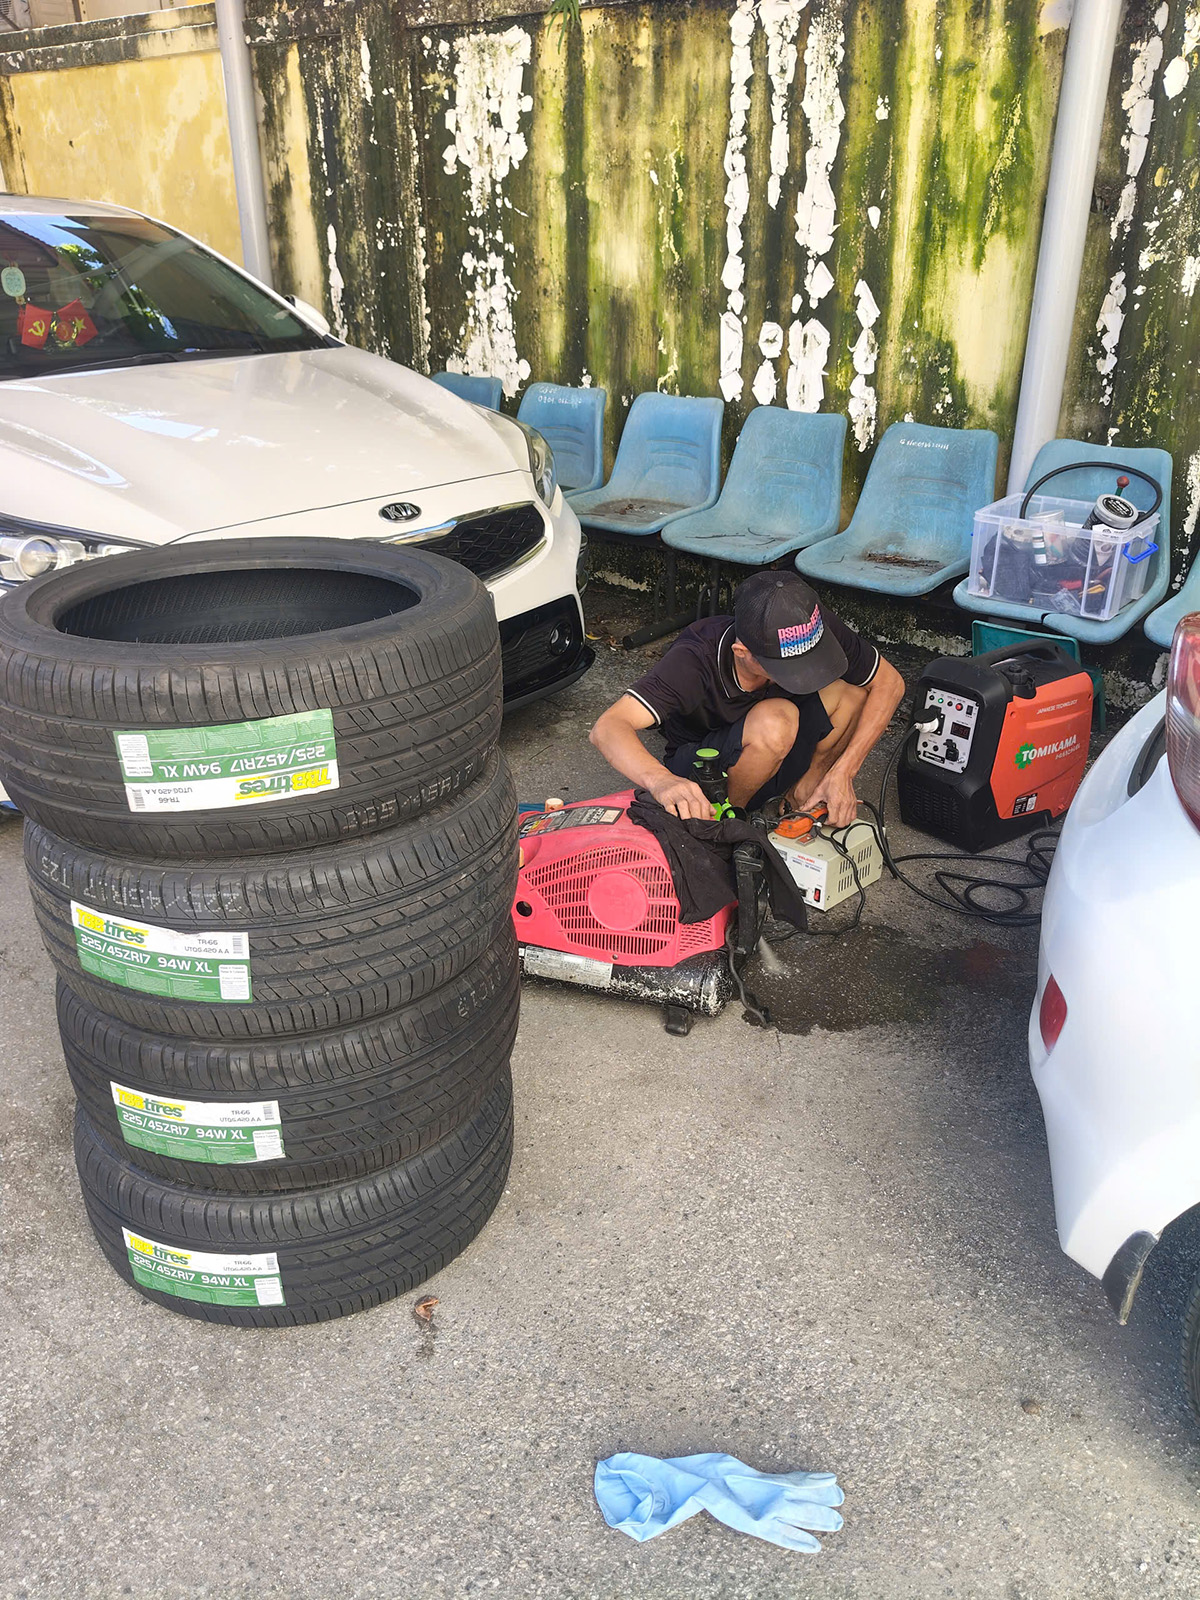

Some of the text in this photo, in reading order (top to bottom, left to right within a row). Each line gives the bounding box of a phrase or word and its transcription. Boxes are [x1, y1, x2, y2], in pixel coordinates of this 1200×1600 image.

[384, 503, 418, 519] KIA
[158, 745, 325, 778] 225/45ZR17 94W XL
[1022, 734, 1077, 761] TOMIKAMA
[159, 796, 180, 804] TR-66
[76, 908, 146, 945] TBBtires
[80, 934, 213, 973] 225/45ZR17 94W XL
[122, 1111, 247, 1140] 225/45ZR17 94W XL
[133, 1253, 249, 1287] 225/45ZR17 94W XL
